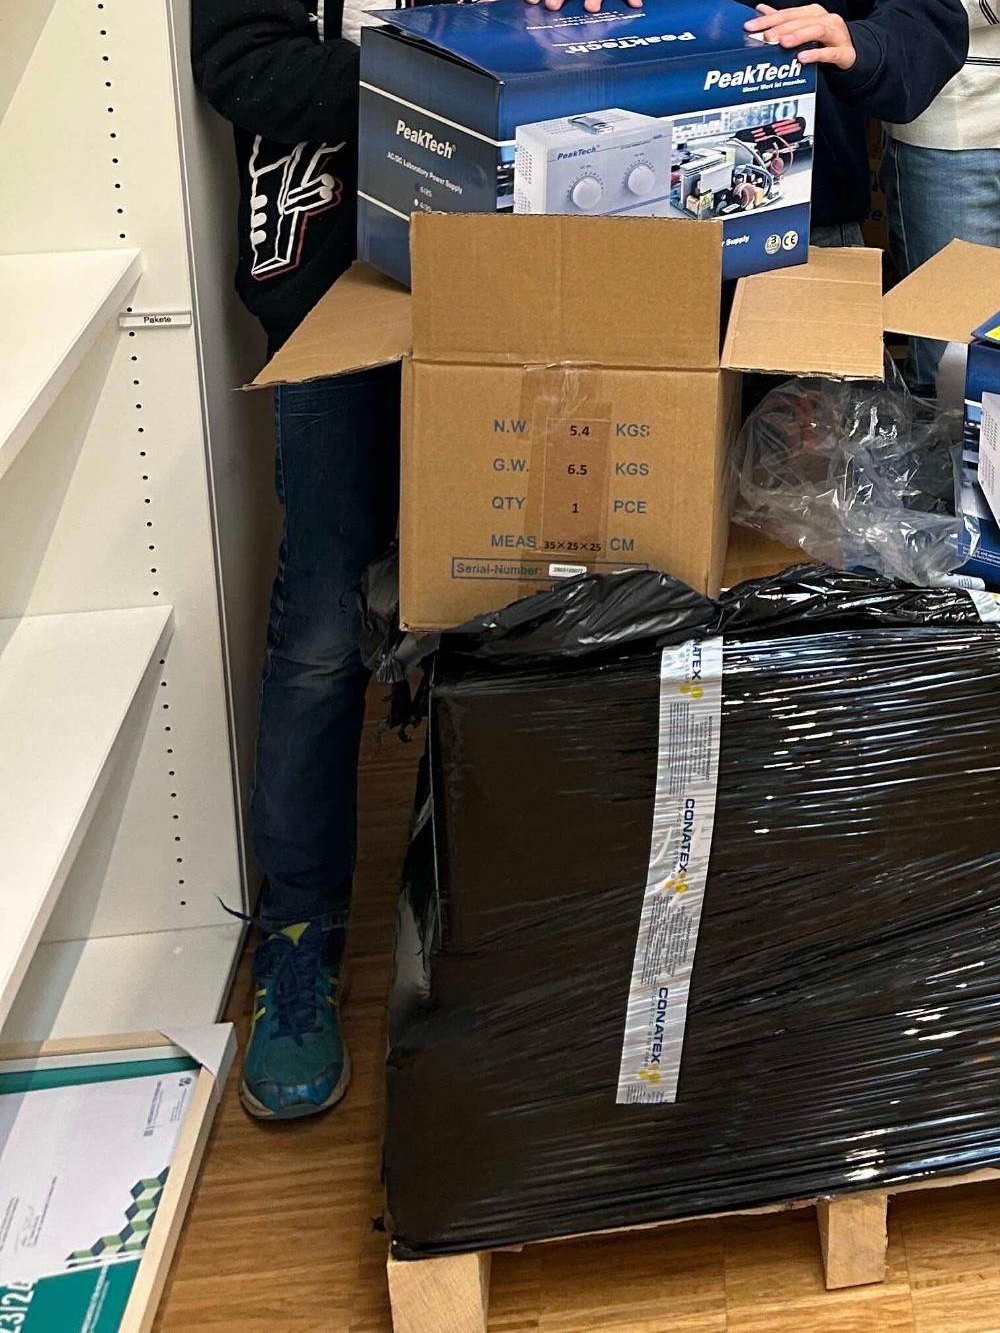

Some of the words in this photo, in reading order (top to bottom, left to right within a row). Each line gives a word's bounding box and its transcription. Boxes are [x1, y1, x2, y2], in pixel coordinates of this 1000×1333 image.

[703, 58, 802, 91] PeakTech
[569, 426, 590, 437] 5.4
[615, 423, 650, 438] KGS
[493, 458, 529, 472] G.W.
[567, 464, 588, 475] 6.5
[615, 463, 649, 476] KGS
[491, 496, 525, 510] QTY
[572, 503, 579, 514] 1
[613, 500, 647, 514] PCE
[610, 538, 634, 551] CM
[678, 798, 695, 873] CONATEX
[650, 987, 669, 1064] CONATEX
